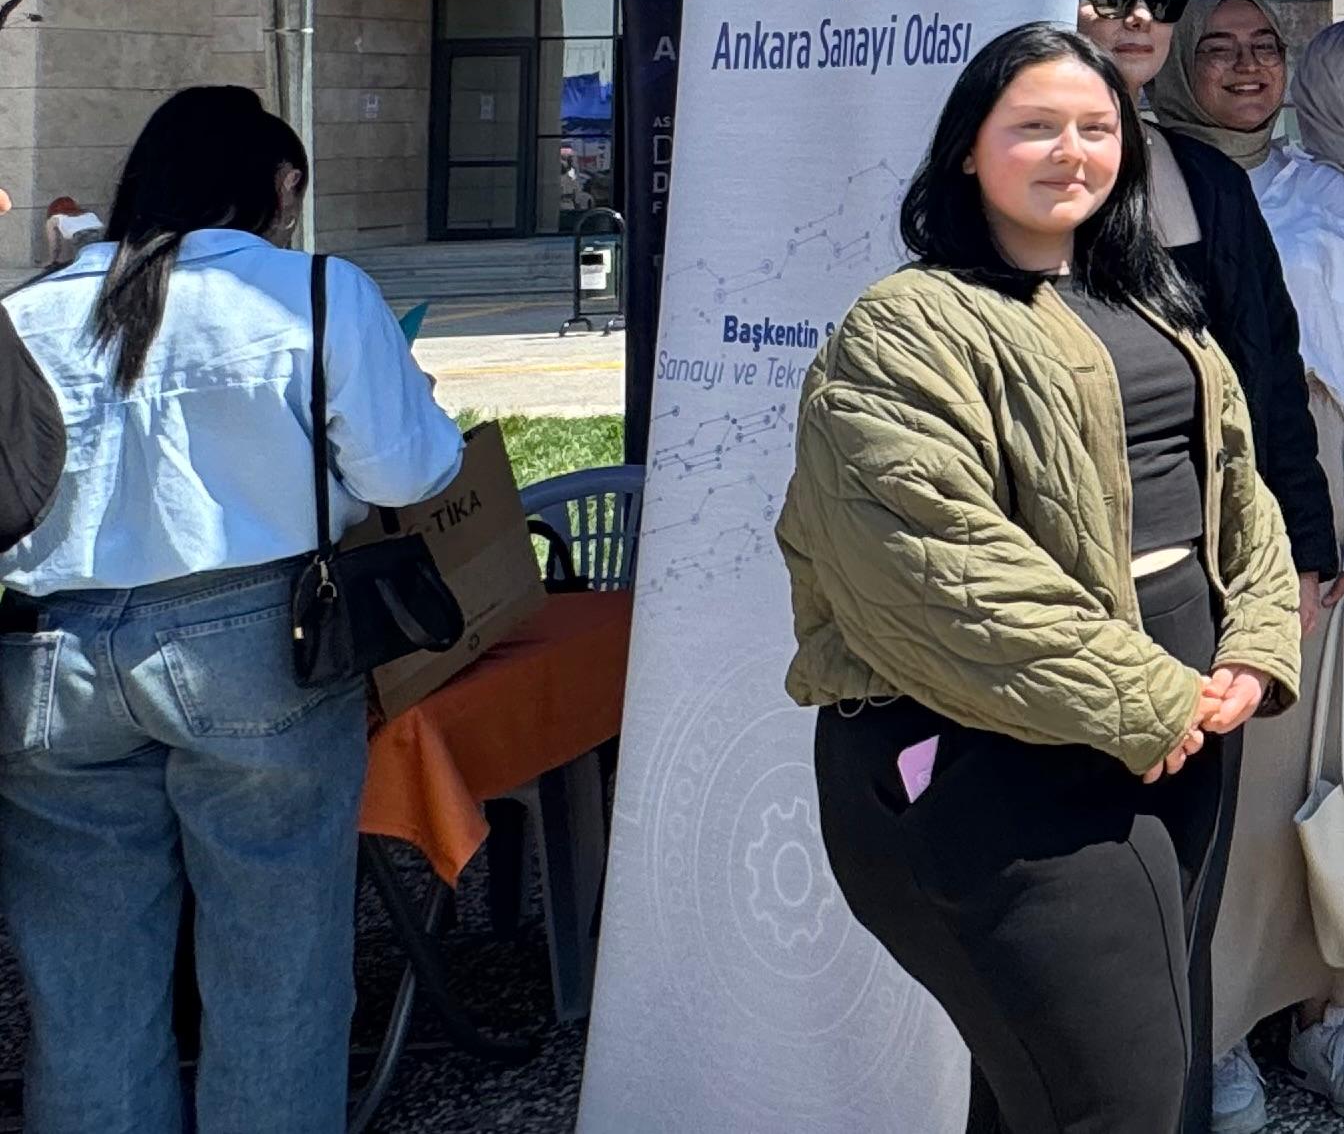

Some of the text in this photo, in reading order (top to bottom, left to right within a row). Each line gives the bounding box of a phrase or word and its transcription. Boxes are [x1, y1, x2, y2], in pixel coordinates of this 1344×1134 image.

[711, 20, 811, 70] Ankara
[817, 14, 898, 75] Sanayi
[904, 12, 972, 66] Odası
[723, 315, 819, 353] Başkentin
[657, 350, 806, 391] Sanayi ve Tek
